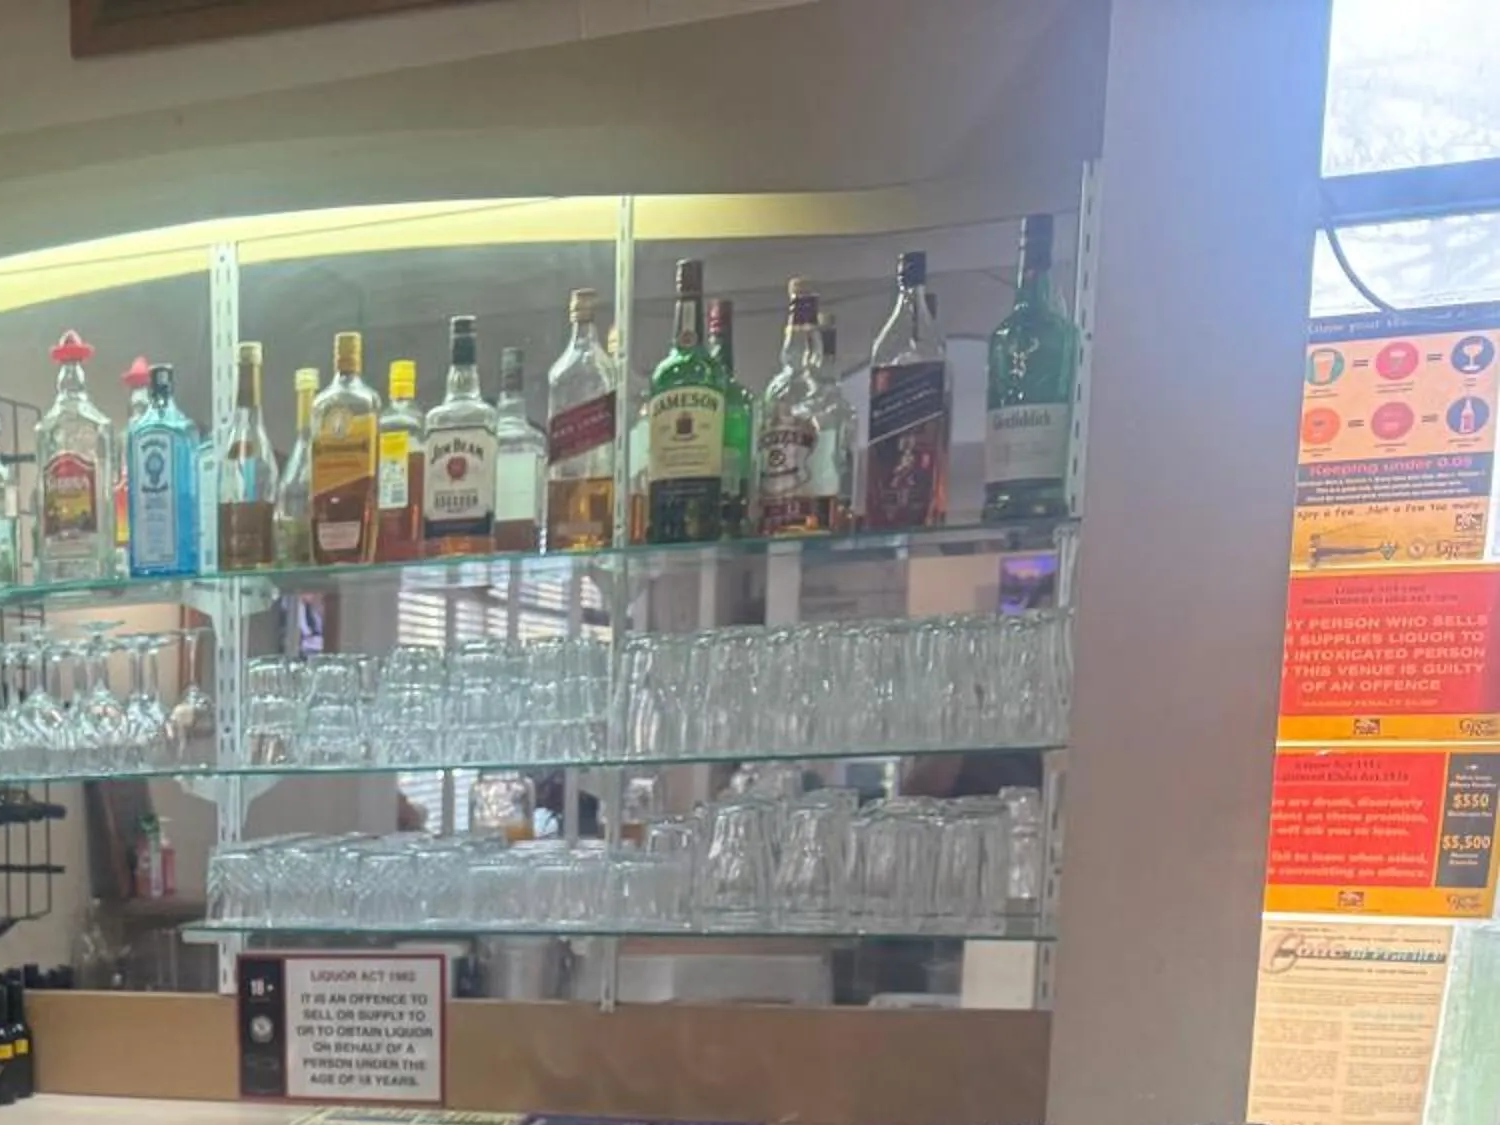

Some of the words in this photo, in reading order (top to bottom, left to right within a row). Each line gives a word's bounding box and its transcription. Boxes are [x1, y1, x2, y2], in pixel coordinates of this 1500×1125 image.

[652, 391, 719, 417] JAMESON
[1308, 616, 1381, 630] PERSON
[1385, 614, 1429, 628] WHO
[1432, 613, 1489, 627] SELLS
[1300, 631, 1383, 646] SUPPLIES
[1388, 630, 1456, 645] LIQUOR
[1459, 630, 1485, 643] TO
[1294, 648, 1409, 662] INTOXICATED
[1412, 646, 1487, 660] PERSON
[1294, 664, 1332, 678] THIS
[1337, 663, 1396, 677] VENUE
[1399, 663, 1415, 676] IS
[1422, 662, 1487, 676] GUILTY
[1301, 680, 1326, 694] OF
[1329, 680, 1355, 693] AN
[1359, 679, 1442, 692] OFFENCE
[1453, 793, 1490, 809] $550
[310, 969, 357, 982] LIQUOR
[361, 970, 384, 982] ACT
[301, 993, 310, 1005] IT
[314, 993, 326, 1005] IS
[329, 993, 346, 1005] AN
[348, 993, 407, 1005] OFFENCE
[411, 993, 429, 1005] TO
[302, 1009, 333, 1021] SELL
[336, 1009, 355, 1021] OR
[357, 1009, 404, 1021] SUPPLY
[407, 1009, 426, 1022] TO
[296, 1025, 314, 1037] OR
[317, 1025, 334, 1037] TO
[336, 1025, 382, 1037] OBTAIN
[384, 1027, 433, 1038] LIQUOR
[334, 1042, 382, 1053] BEHALF
[386, 1042, 401, 1054] OF
[405, 1042, 415, 1053] A
[302, 1058, 353, 1070] PERSON
[355, 1058, 399, 1070] UNDER
[402, 1059, 426, 1071] THE
[309, 1073, 334, 1085] AGE
[337, 1073, 355, 1085] OF
